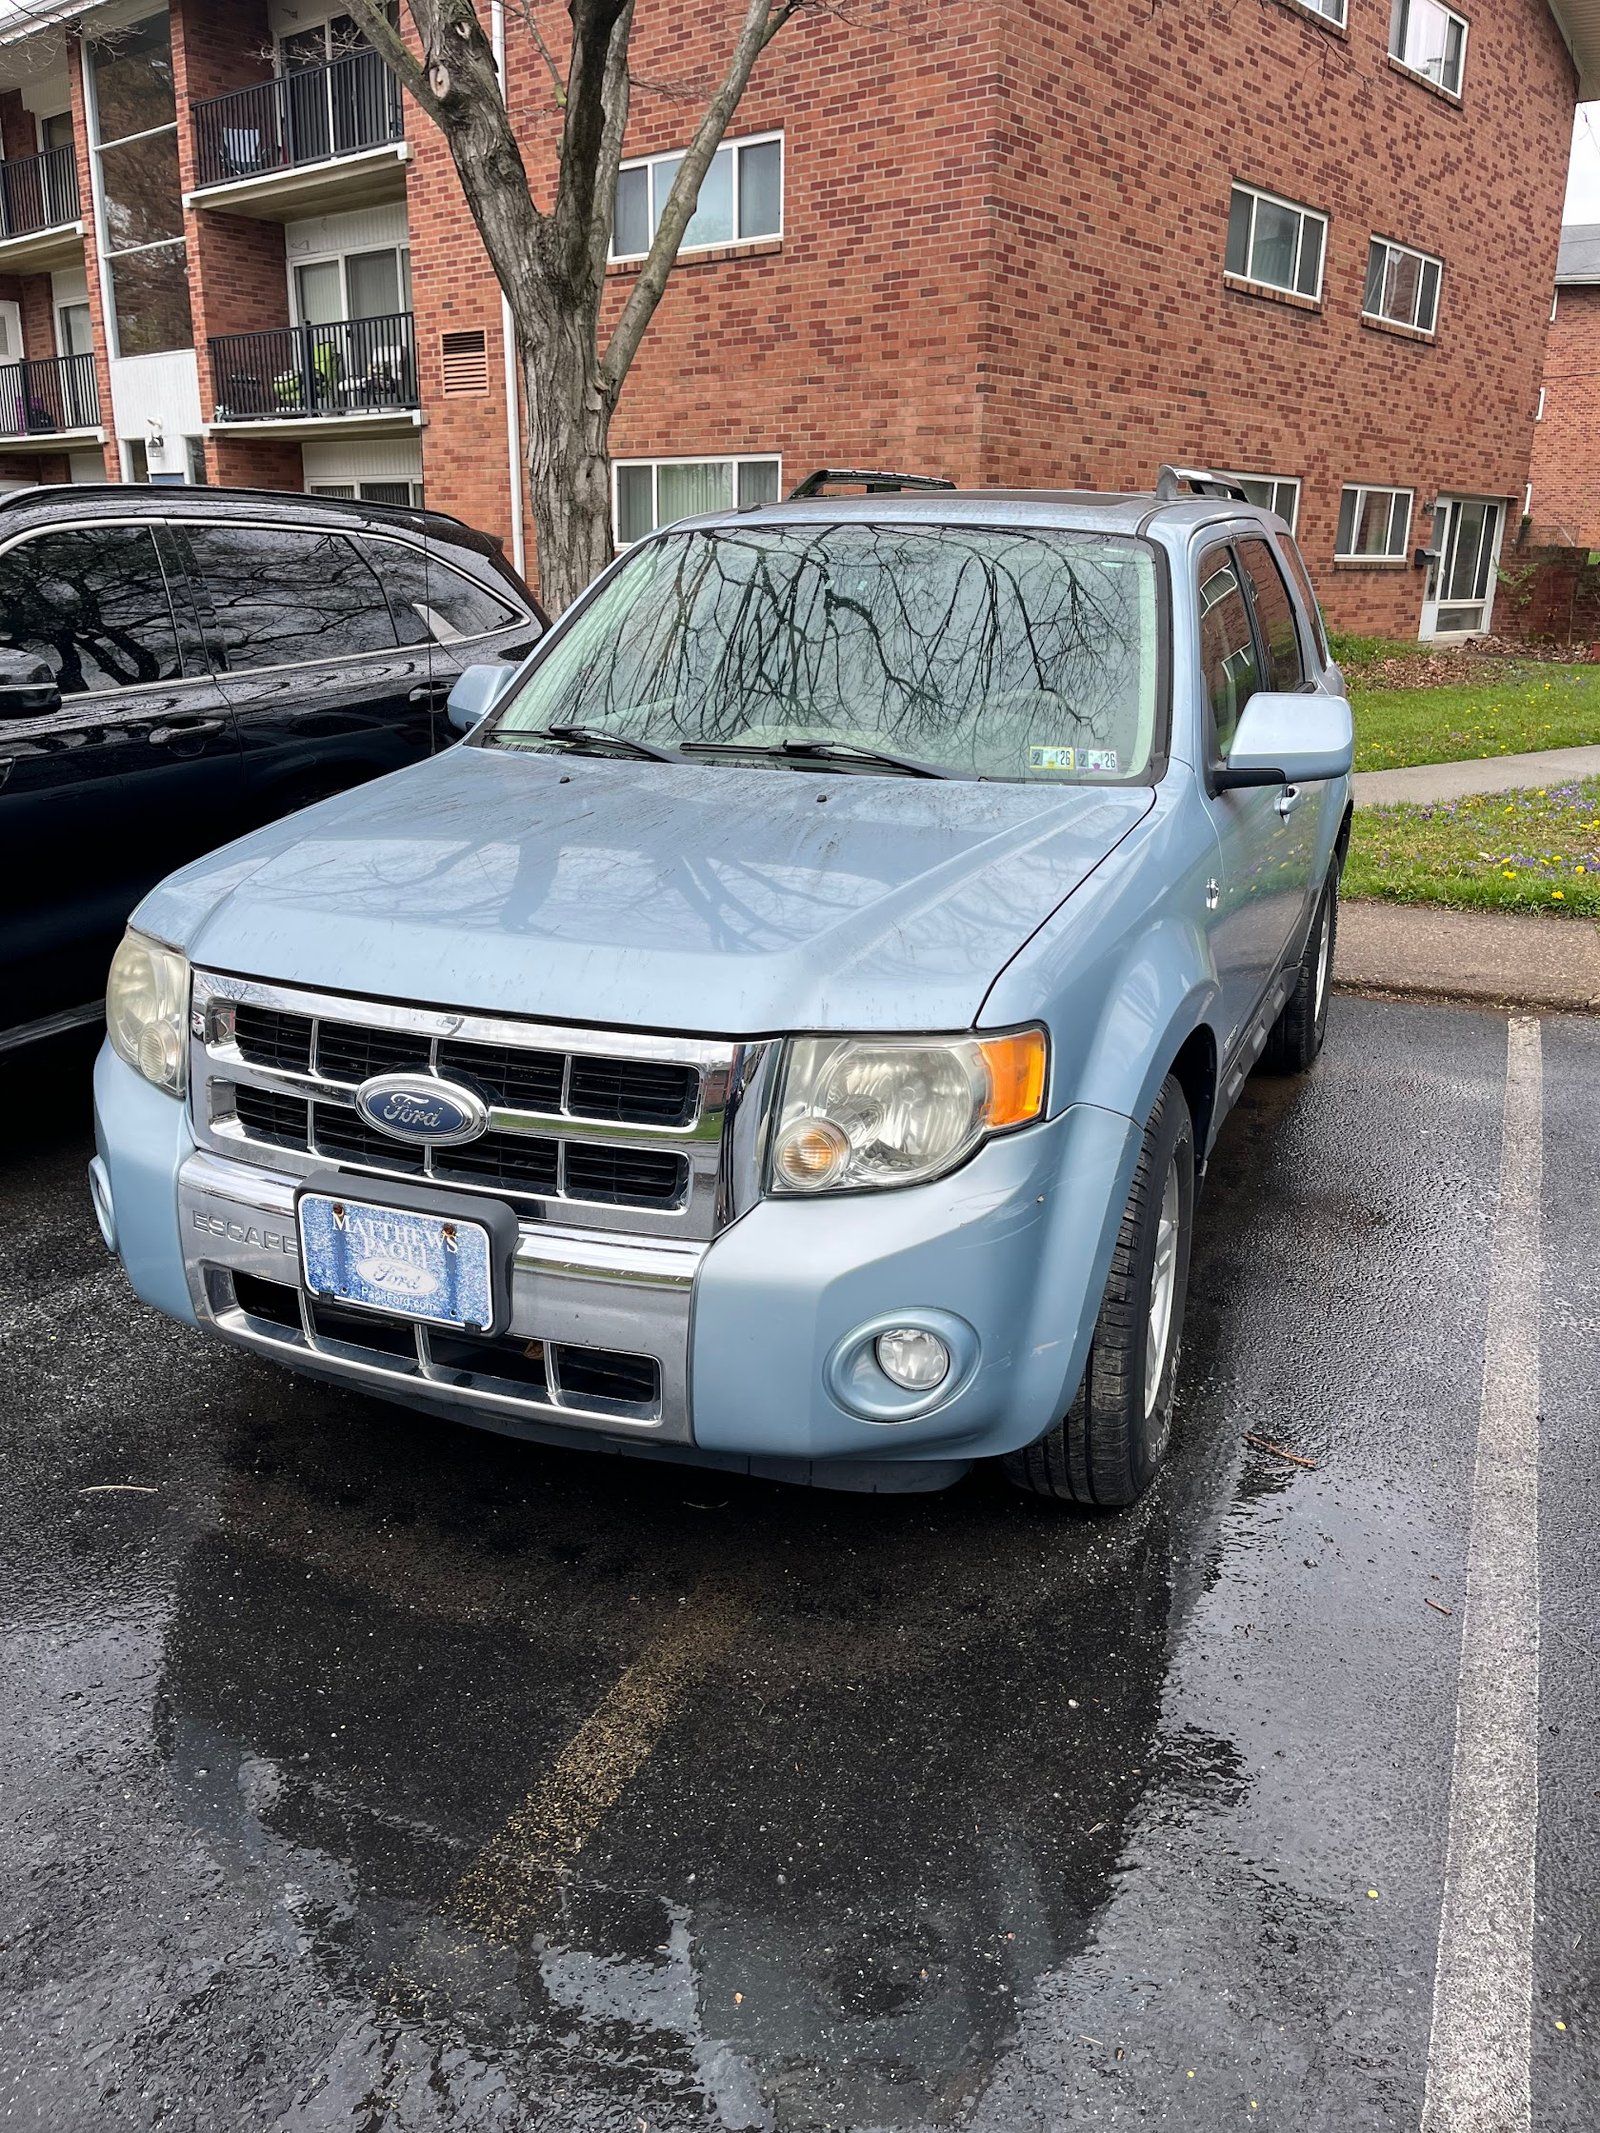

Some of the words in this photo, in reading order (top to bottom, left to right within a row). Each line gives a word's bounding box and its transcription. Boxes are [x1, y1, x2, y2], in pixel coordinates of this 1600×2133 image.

[1060, 750, 1071, 766] 26
[1104, 753, 1116, 768] 26
[383, 1093, 443, 1127] Ford
[193, 1210, 299, 1258] ESCAPE
[332, 1211, 459, 1253] MATTHEWS
[363, 1236, 428, 1269] PAOLI
[373, 1261, 421, 1290] Ford
